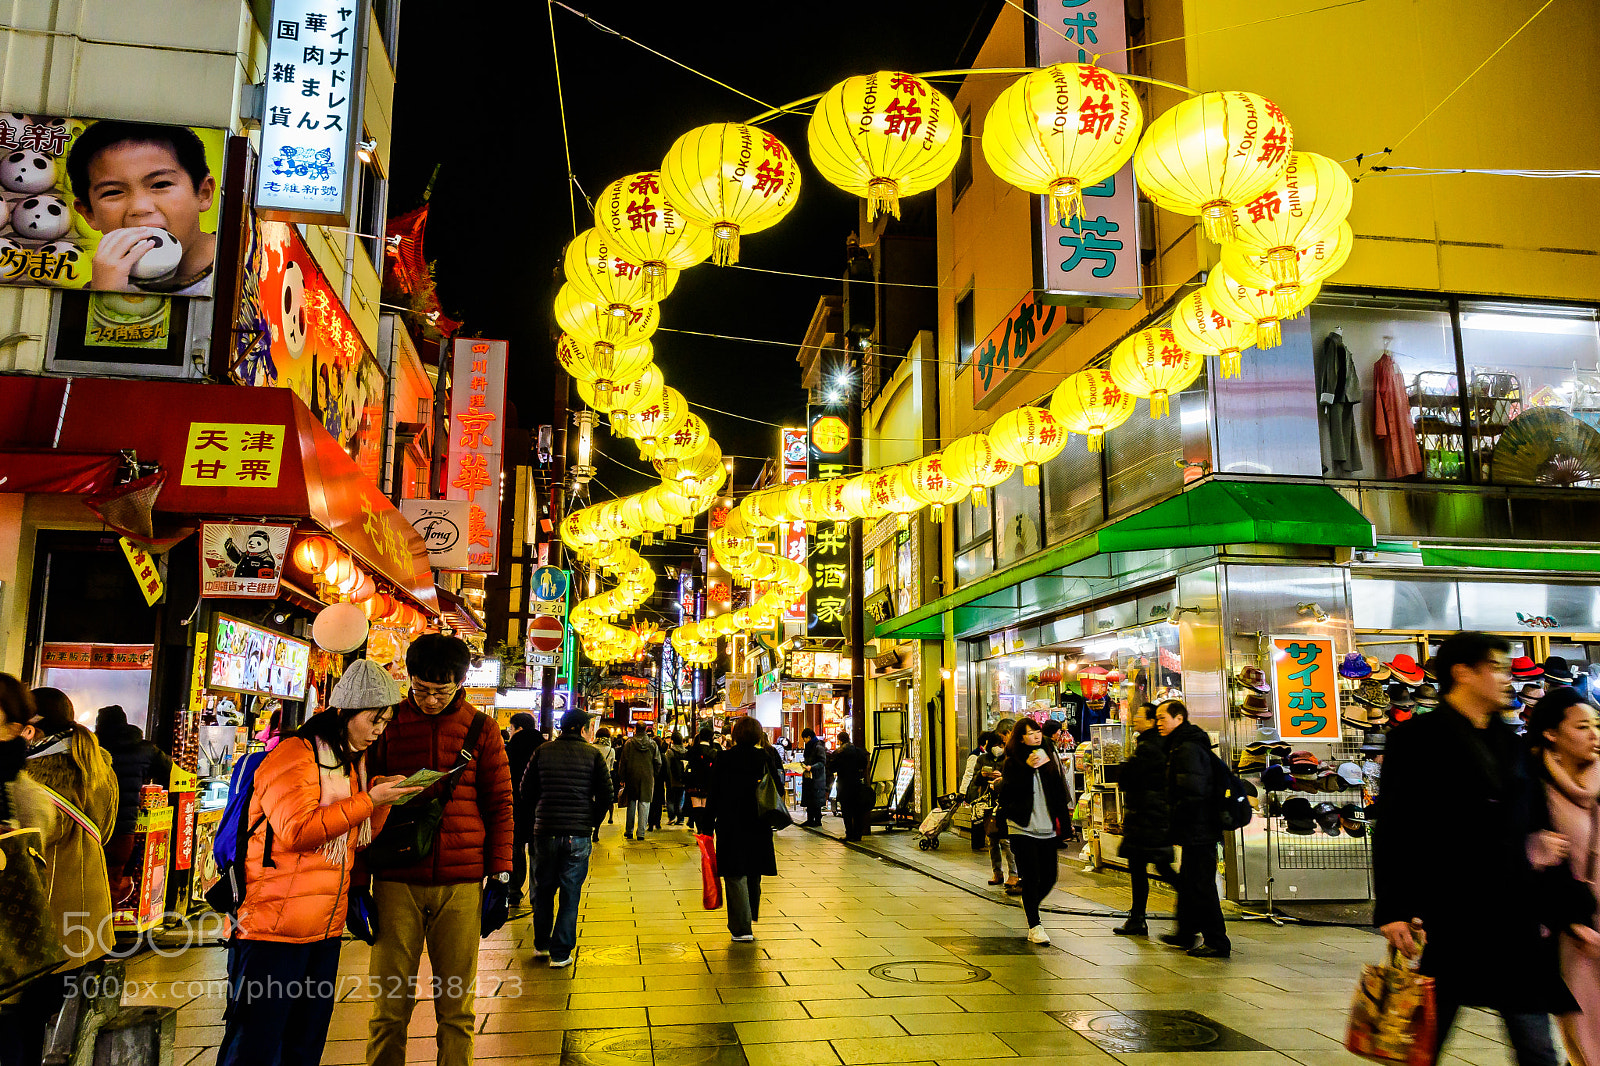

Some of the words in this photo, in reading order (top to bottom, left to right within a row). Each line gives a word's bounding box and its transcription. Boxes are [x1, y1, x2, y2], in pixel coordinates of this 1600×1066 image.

[269, 20, 299, 127] 国雑貨
[297, 13, 327, 130] 華肉まん
[323, 7, 352, 131] ャイナドレス
[1078, 65, 1115, 140] 春節
[884, 72, 926, 142] 春節
[752, 131, 788, 198] 春節
[626, 173, 659, 233] 春節
[470, 343, 490, 407] 四川料理
[191, 459, 272, 480] 甘栗
[195, 430, 275, 452] 天津
[420, 508, 450, 517] フォーン
[815, 464, 847, 623] 王井酒家
[1286, 642, 1328, 736] サイホウ
